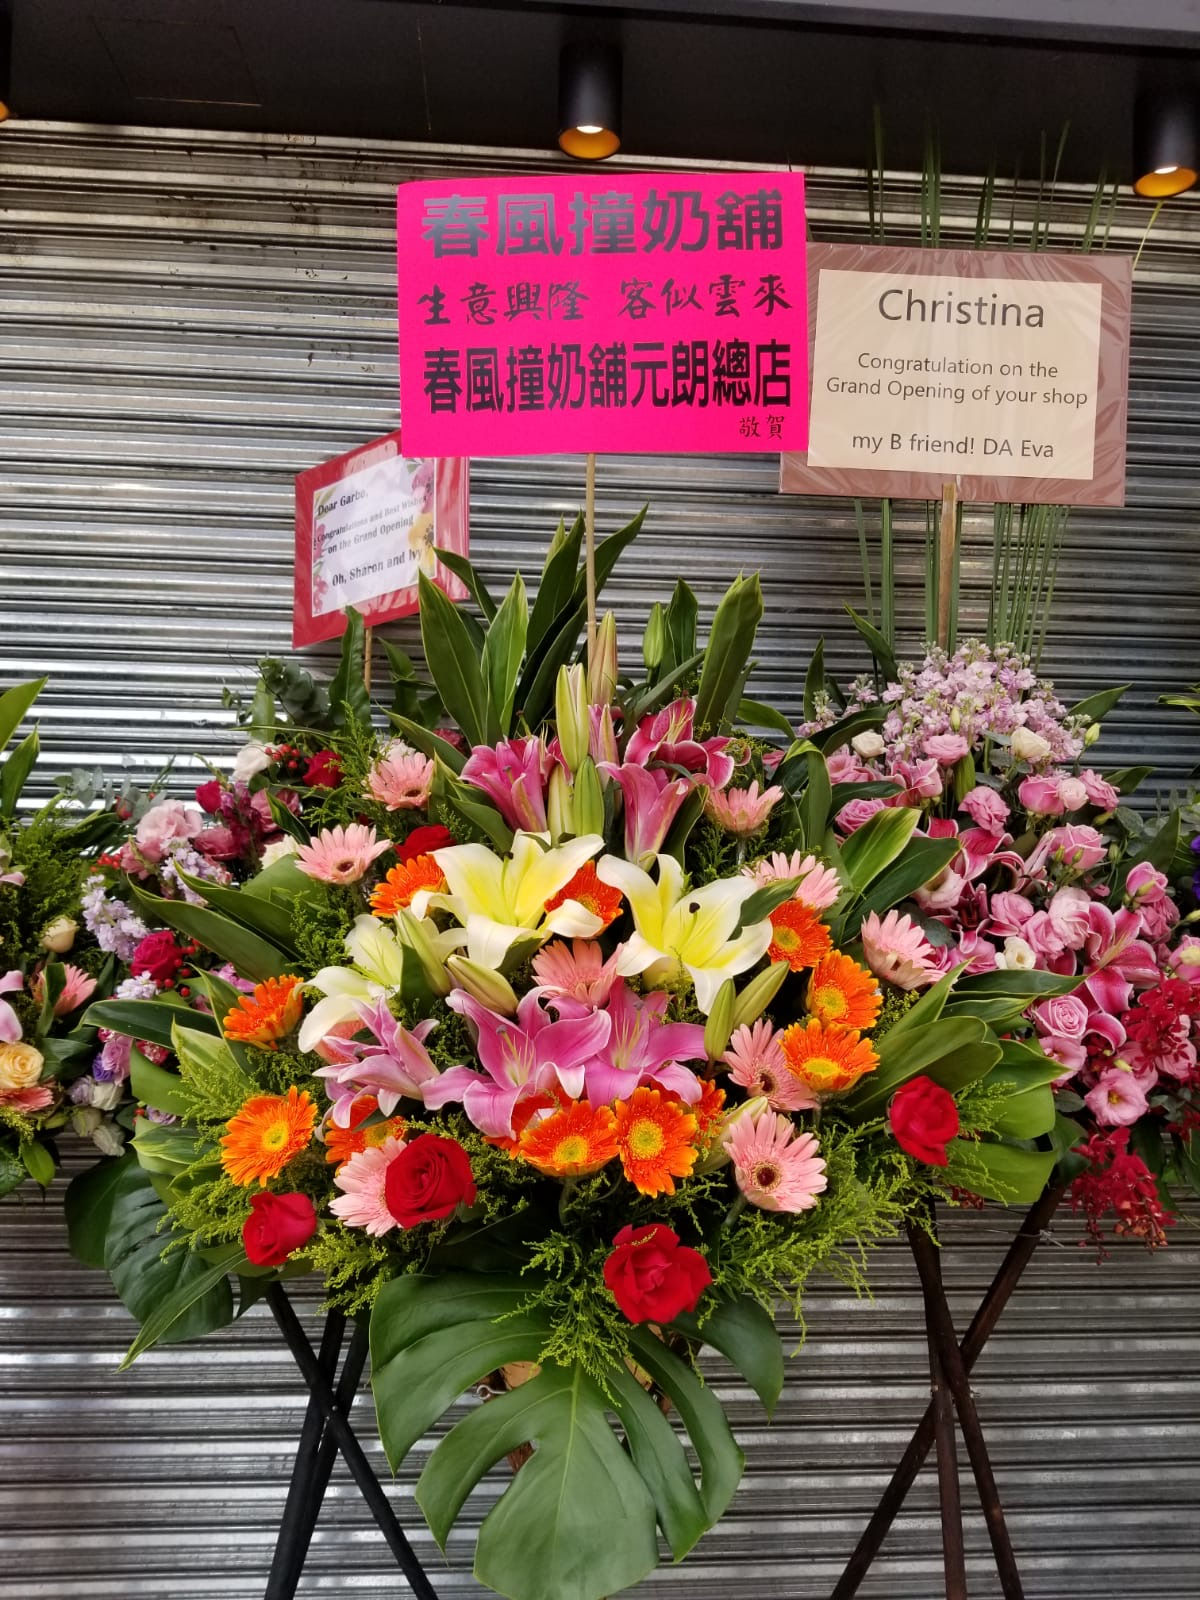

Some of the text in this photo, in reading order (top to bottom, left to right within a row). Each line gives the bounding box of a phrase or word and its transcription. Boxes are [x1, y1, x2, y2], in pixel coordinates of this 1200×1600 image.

[421, 188, 783, 258] 春風撞奶舖
[416, 274, 792, 325] 生意興隆 客似雲來
[878, 288, 1044, 328] Christina
[423, 338, 791, 414] 春風撞奶舖元朗總店
[857, 352, 1058, 378] Congratulation on the
[826, 377, 1088, 408] Grand Opening of your shop
[739, 413, 784, 440] 敬賀
[852, 433, 1054, 458] my B friend! DA Eva
[317, 500, 338, 517] Dear
[328, 544, 337, 554] on
[354, 527, 377, 545] Grand
[380, 515, 413, 535] Opening
[349, 562, 383, 581] Sharon
[387, 552, 405, 569] and
